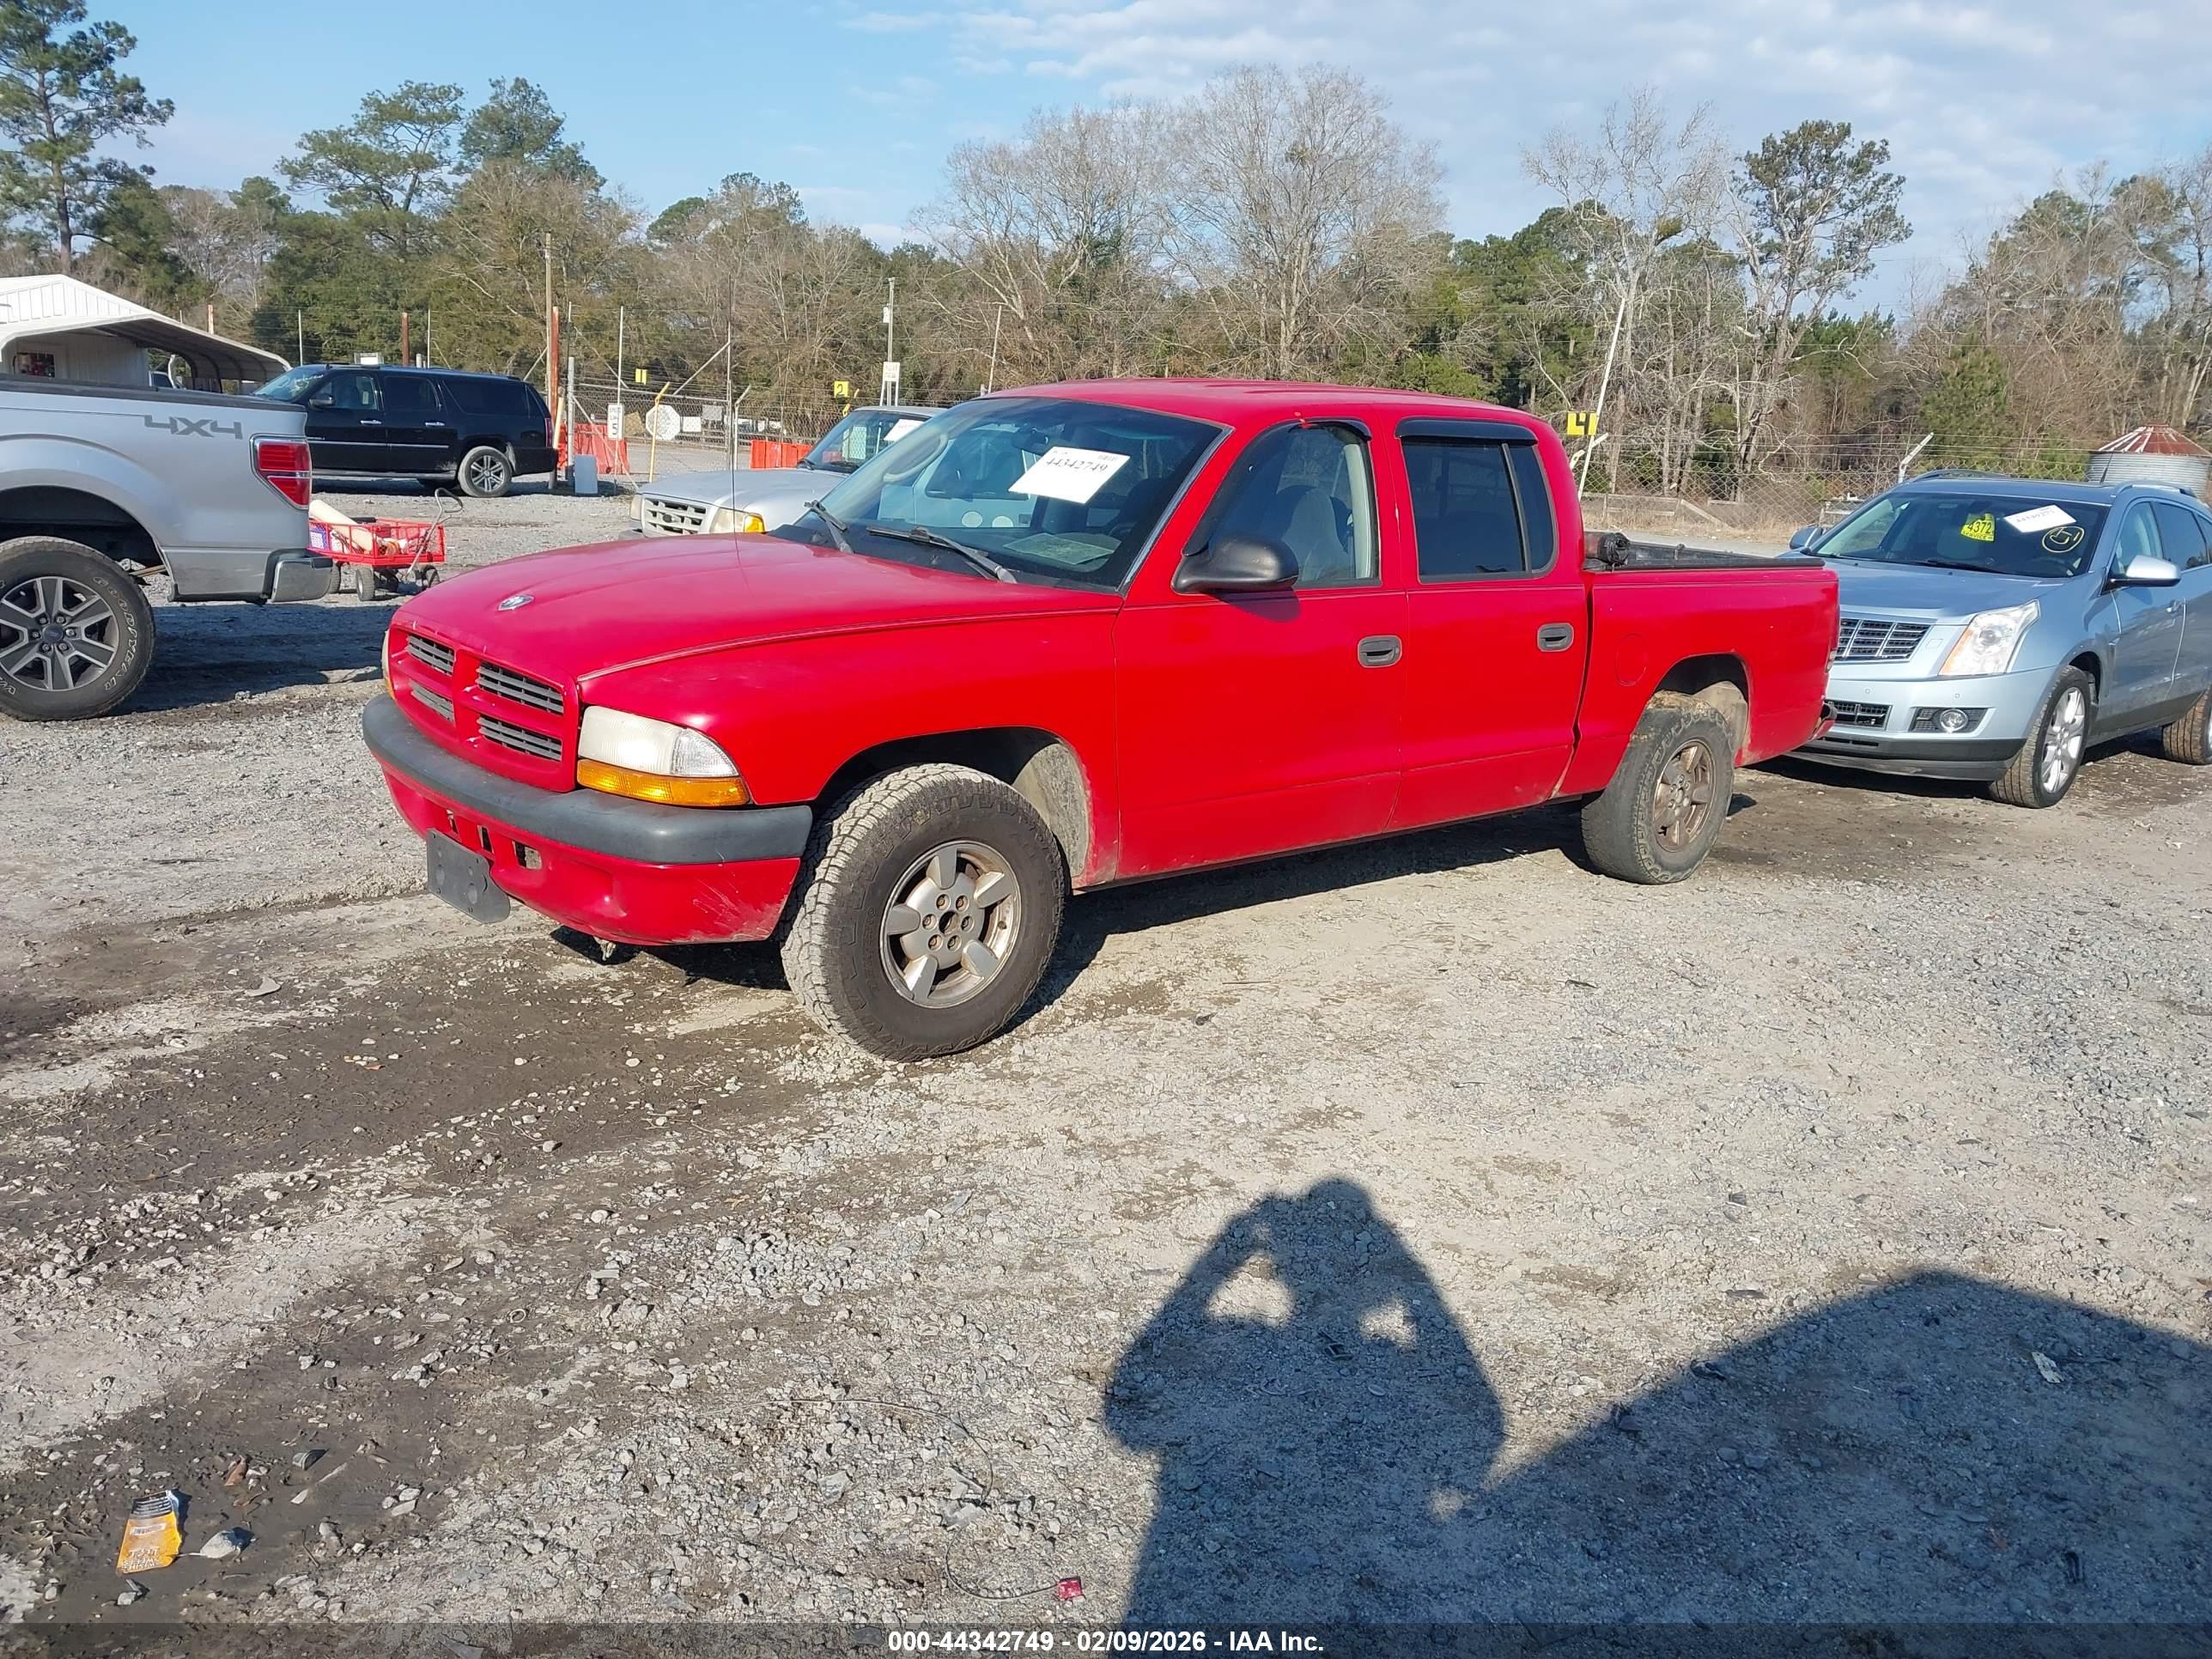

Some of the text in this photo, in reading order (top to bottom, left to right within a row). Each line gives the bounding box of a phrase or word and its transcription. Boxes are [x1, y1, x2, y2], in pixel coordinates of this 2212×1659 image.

[836, 383, 847, 396] 2
[144, 415, 242, 440] 4X4
[612, 423, 617, 434] 5
[1576, 412, 1589, 434] 4
[1046, 458, 1108, 471] 44342749
